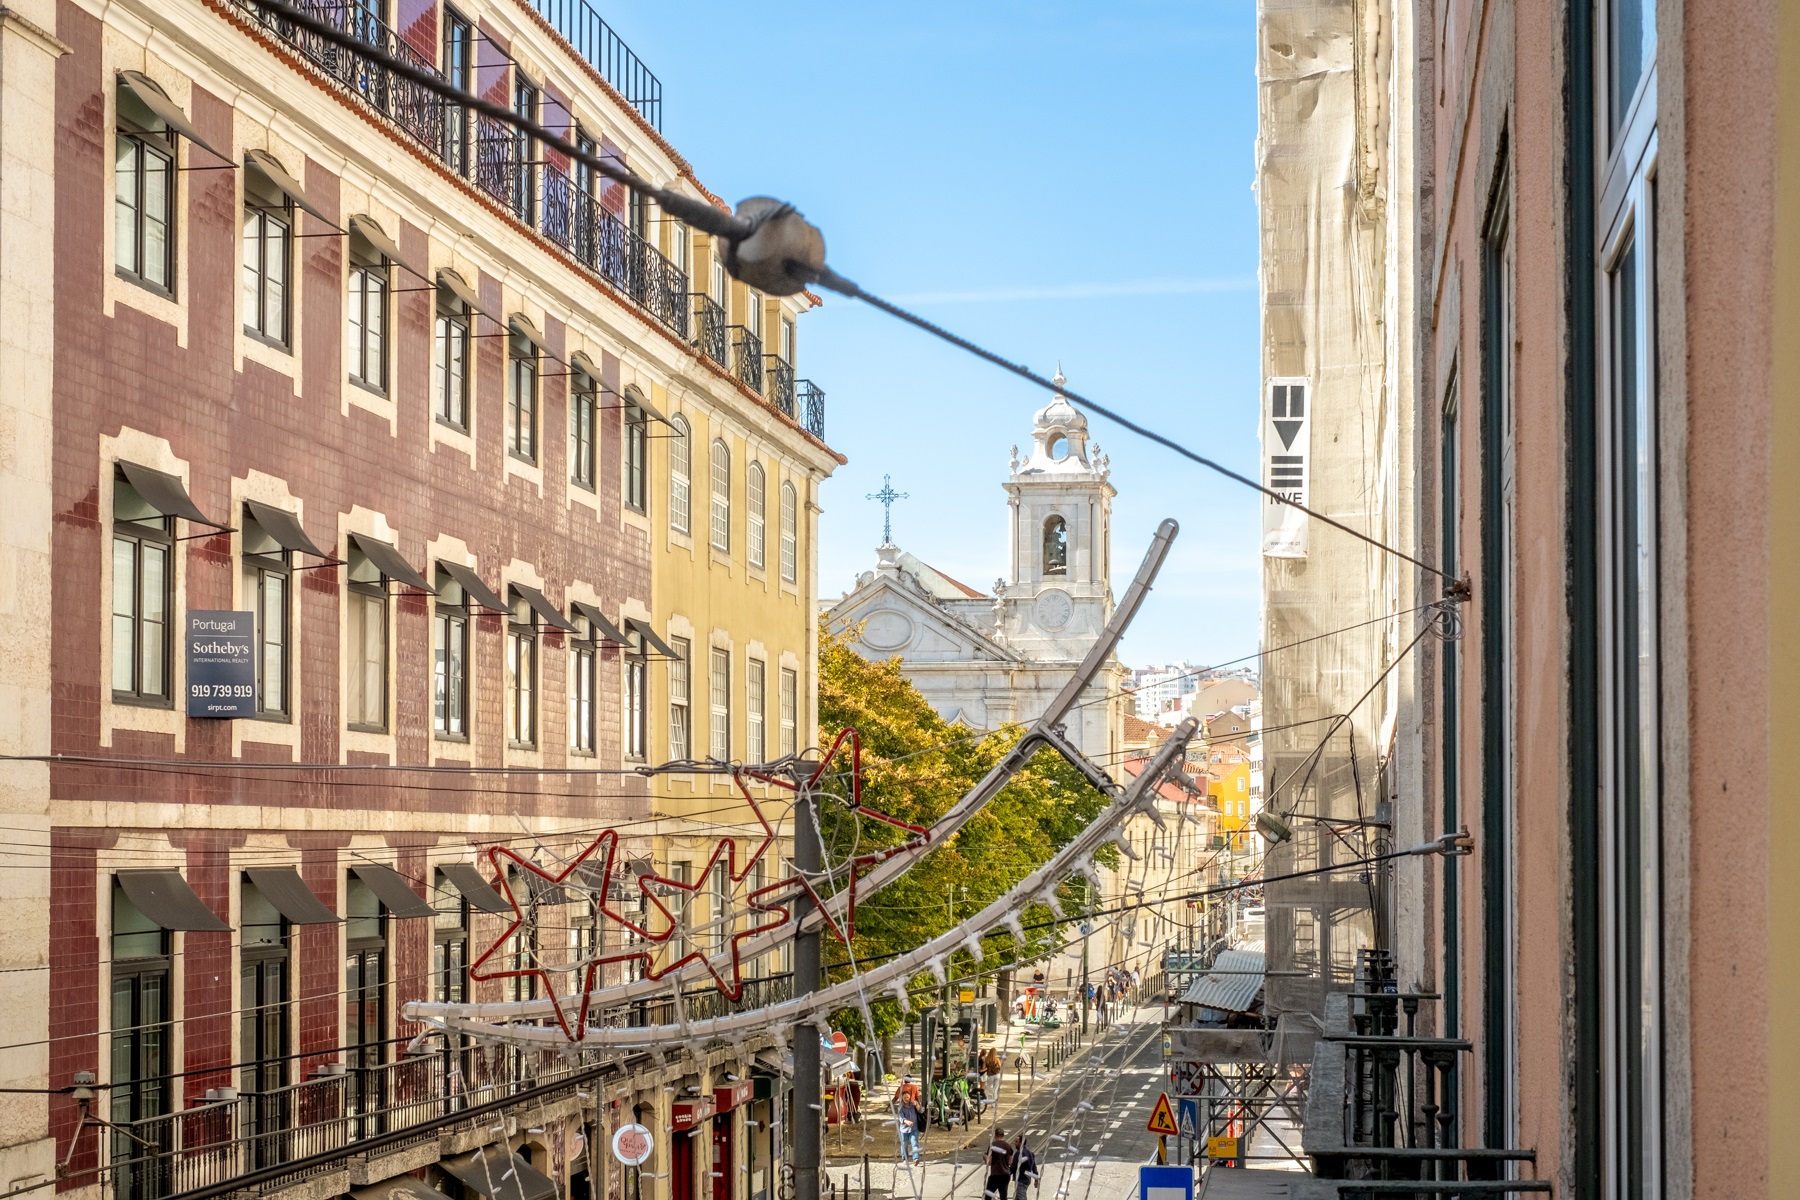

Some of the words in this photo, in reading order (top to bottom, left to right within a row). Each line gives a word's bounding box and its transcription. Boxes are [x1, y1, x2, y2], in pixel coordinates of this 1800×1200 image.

[1270, 492, 1302, 504] NVE
[192, 619, 236, 632] Portugal
[193, 641, 249, 657] Sotheby's
[191, 685, 210, 697] 919
[212, 685, 231, 697] 739
[233, 685, 252, 697] 919
[208, 704, 237, 712] sirpt.com
